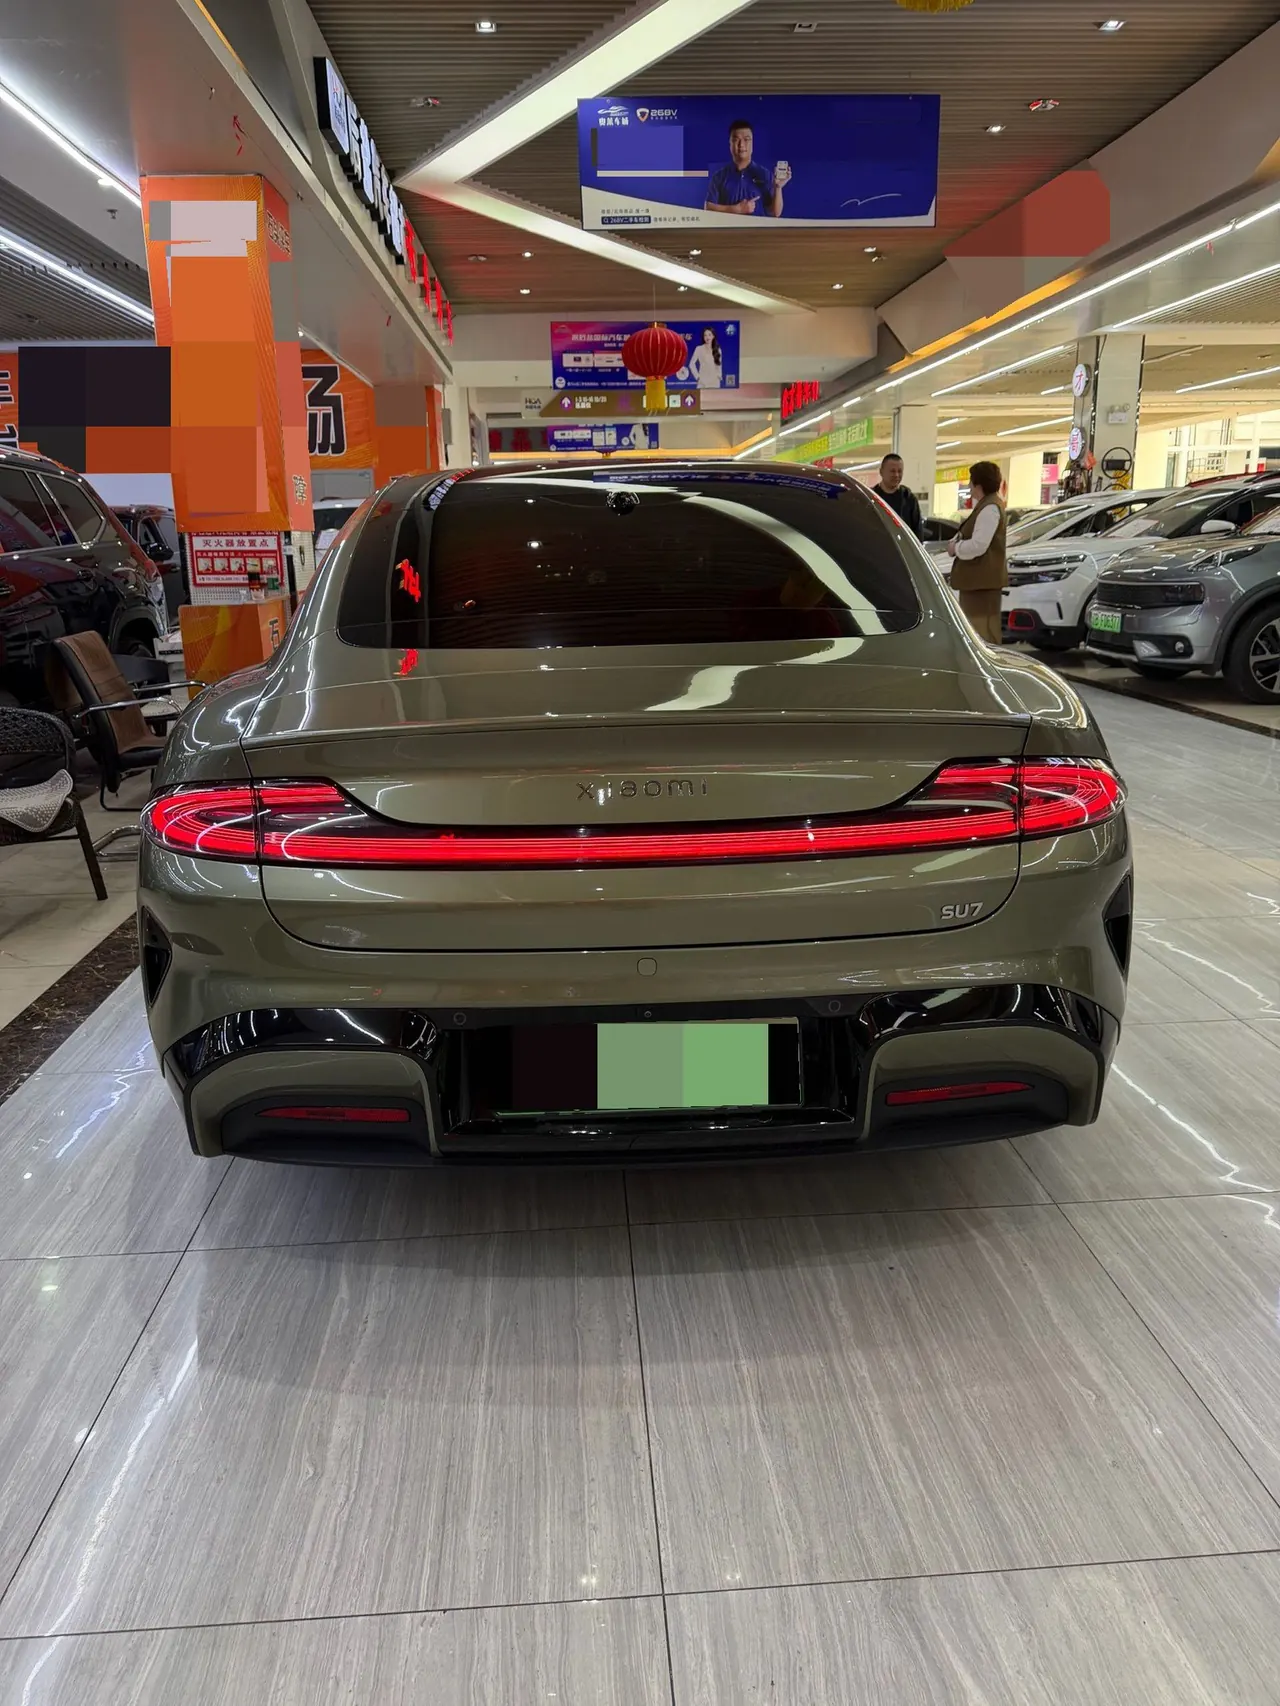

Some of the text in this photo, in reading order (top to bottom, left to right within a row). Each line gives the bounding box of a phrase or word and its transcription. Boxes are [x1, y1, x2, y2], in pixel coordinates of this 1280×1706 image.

[650, 109, 678, 117] 268V
[202, 538, 270, 548] 灭火器放置点
[576, 778, 708, 800] xiaomi
[941, 901, 984, 920] SU7
